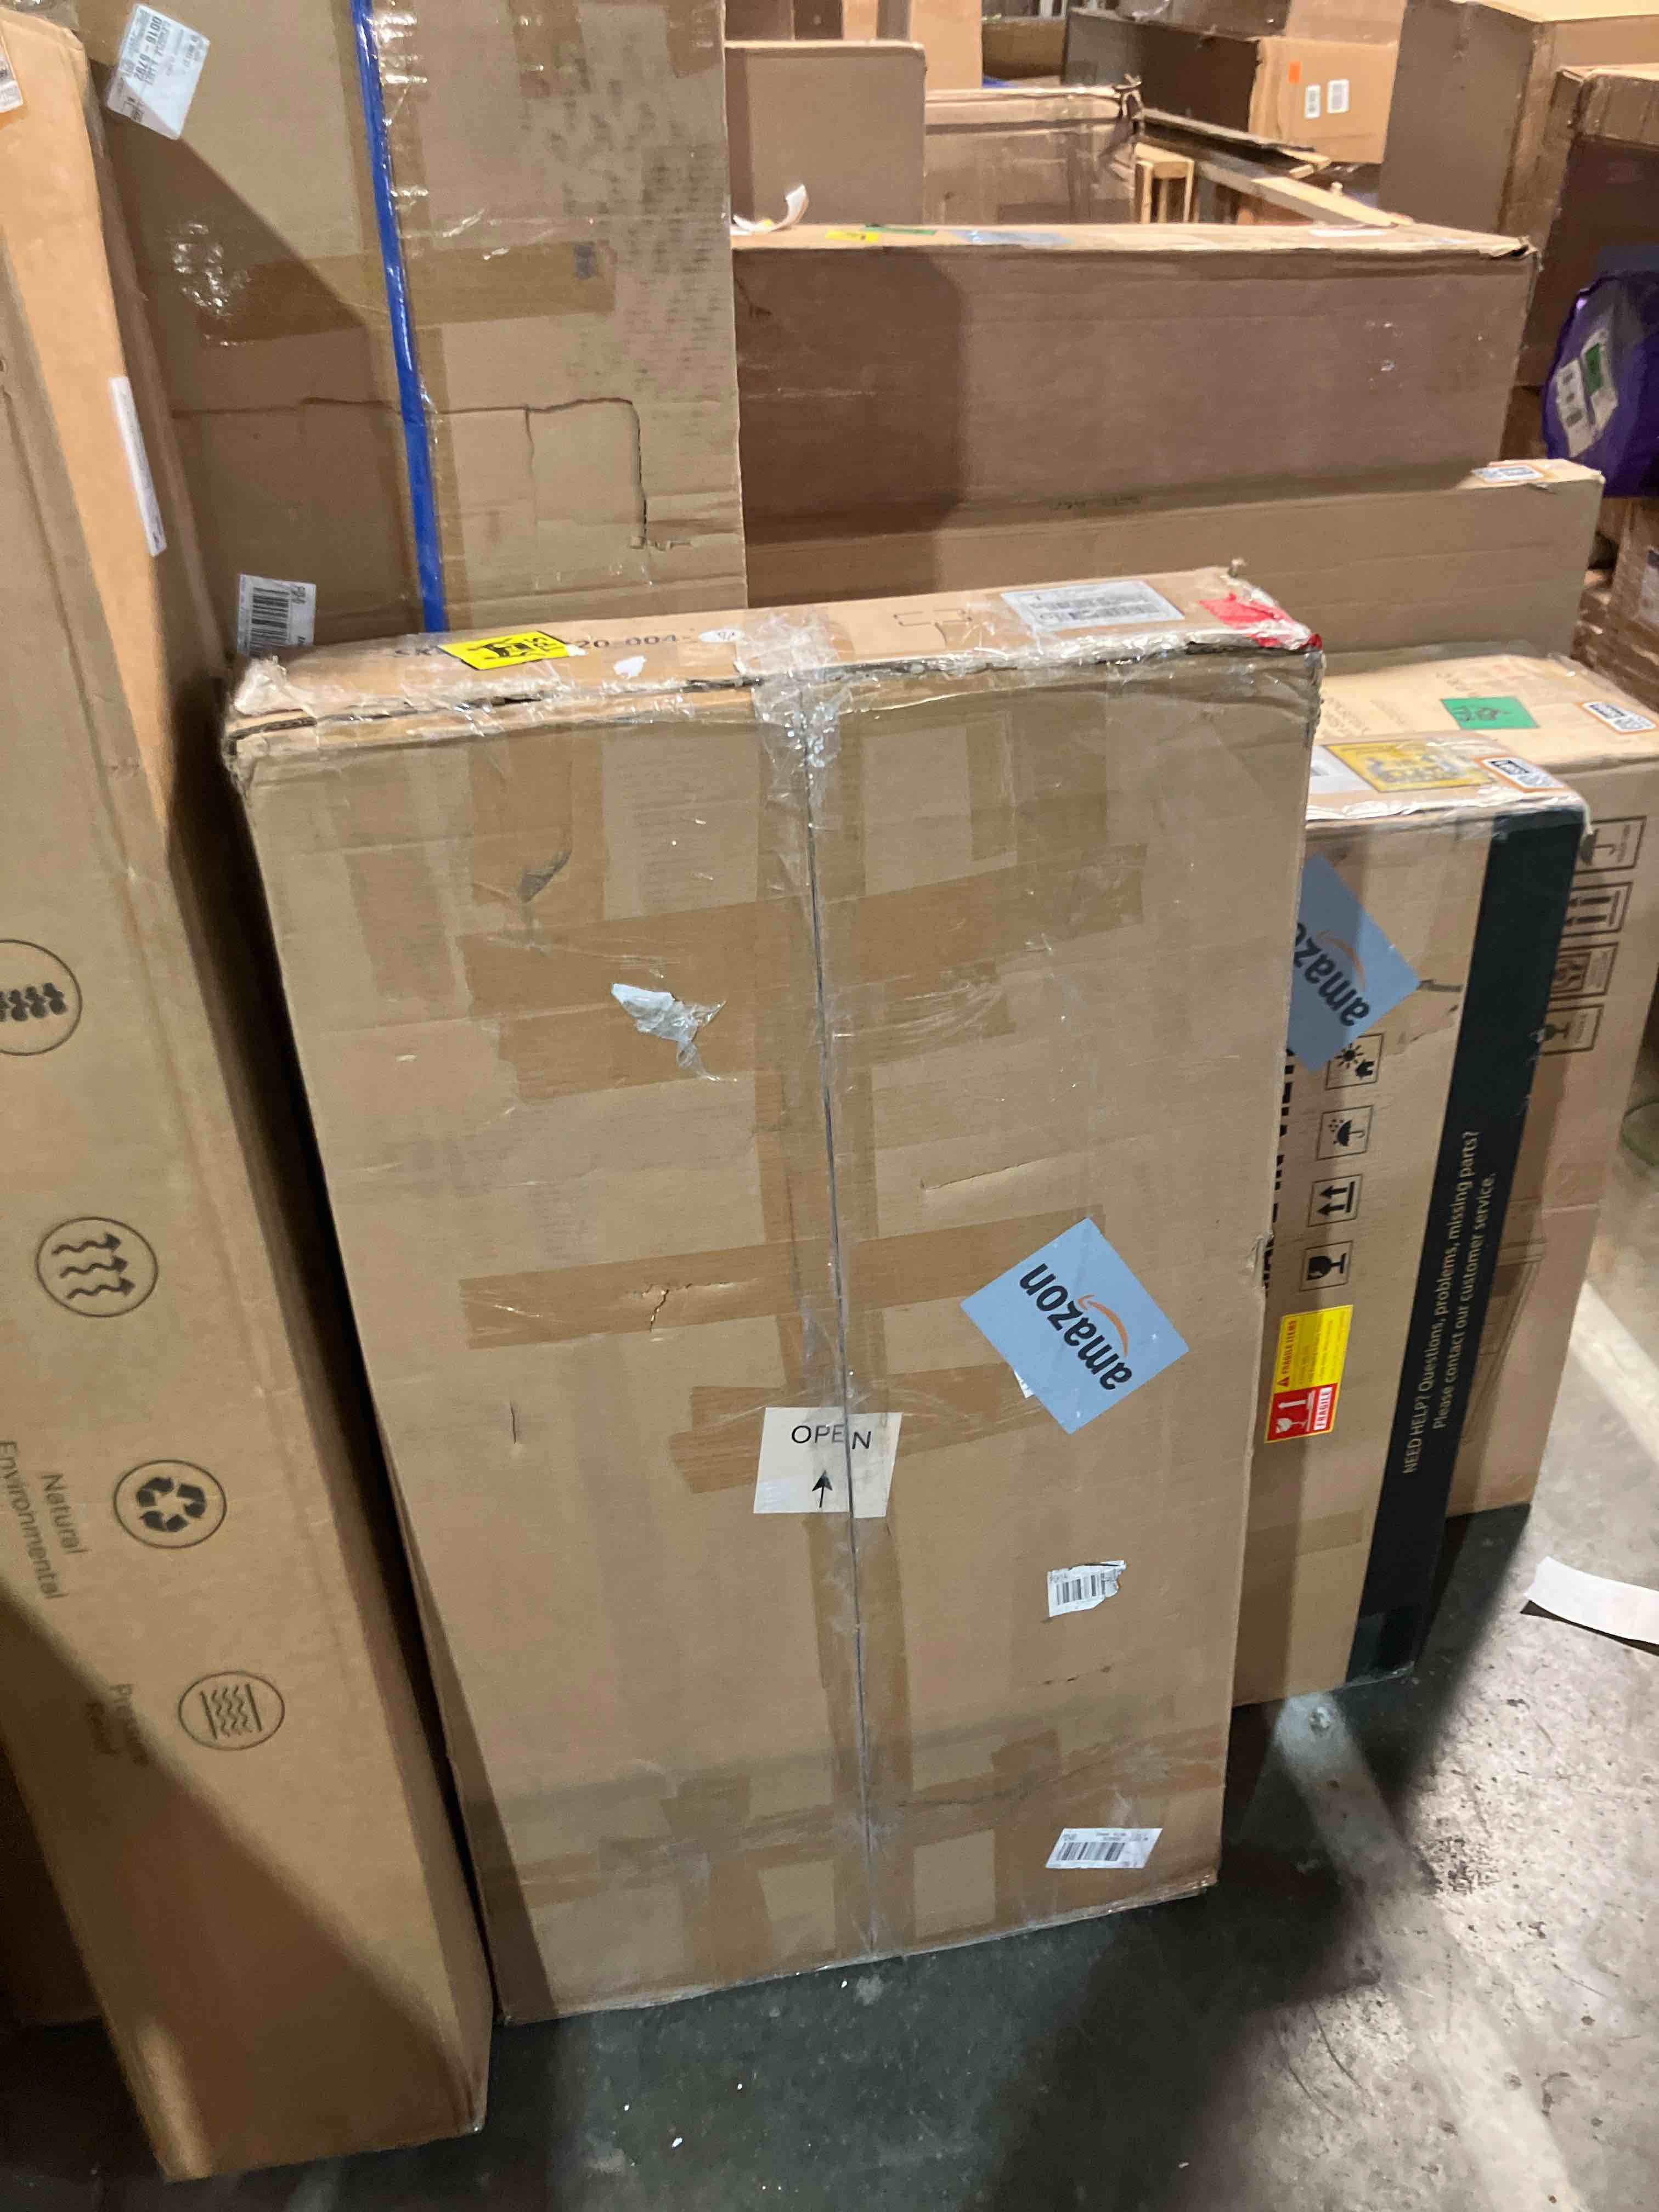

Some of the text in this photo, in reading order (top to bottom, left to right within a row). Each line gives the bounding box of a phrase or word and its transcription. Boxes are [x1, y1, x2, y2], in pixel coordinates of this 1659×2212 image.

[1019, 1263, 1132, 1390] amazon
[1402, 1131, 1481, 1474] NEED HELP? Questions, problems, missing parts?
[1432, 1172, 1498, 1430] Please contact our customer service.
[792, 1424, 871, 1449] OPEN
[1316, 1387, 1331, 1430] FRAGILE
[0, 1440, 70, 1599] Environmental
[40, 1473, 92, 1554] Natural
